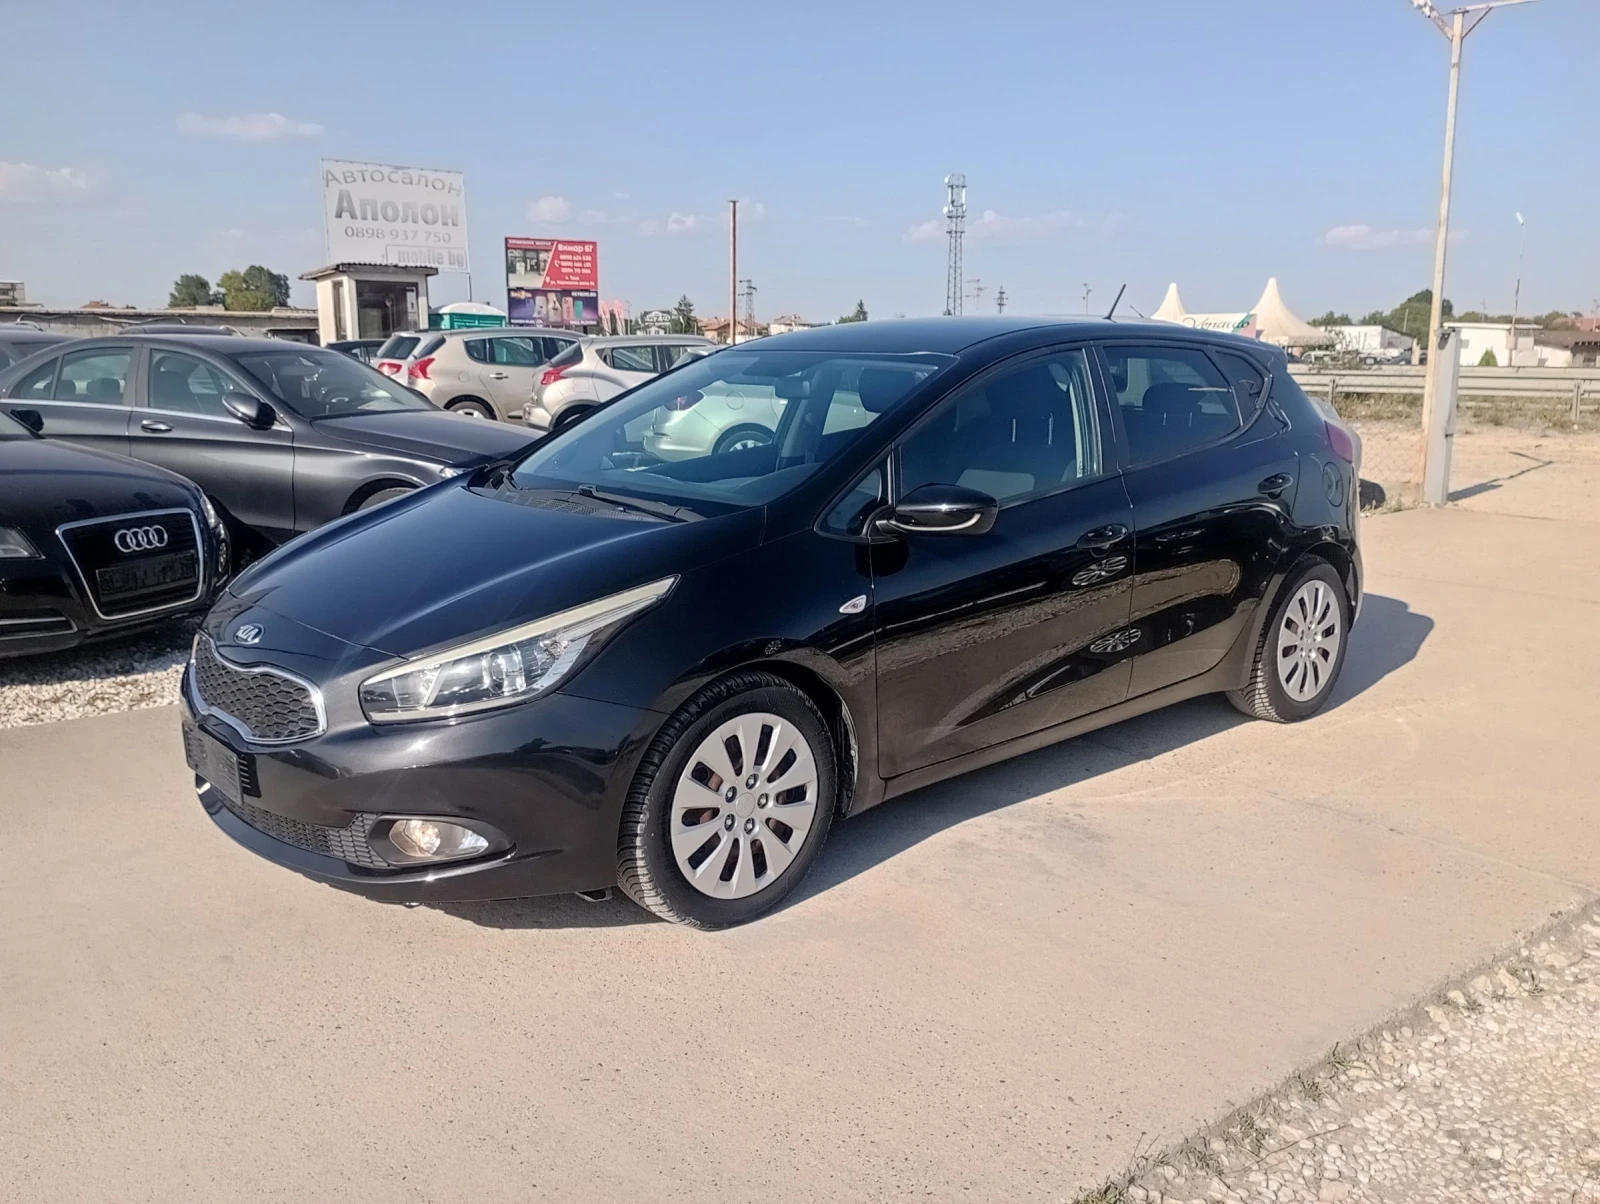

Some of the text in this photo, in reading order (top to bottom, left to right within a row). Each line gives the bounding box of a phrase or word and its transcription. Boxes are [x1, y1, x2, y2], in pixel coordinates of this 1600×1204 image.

[325, 169, 462, 197] Автосалон
[335, 189, 459, 227] Аполон
[345, 226, 451, 243] 0898 937 750
[236, 624, 260, 642] KIA
